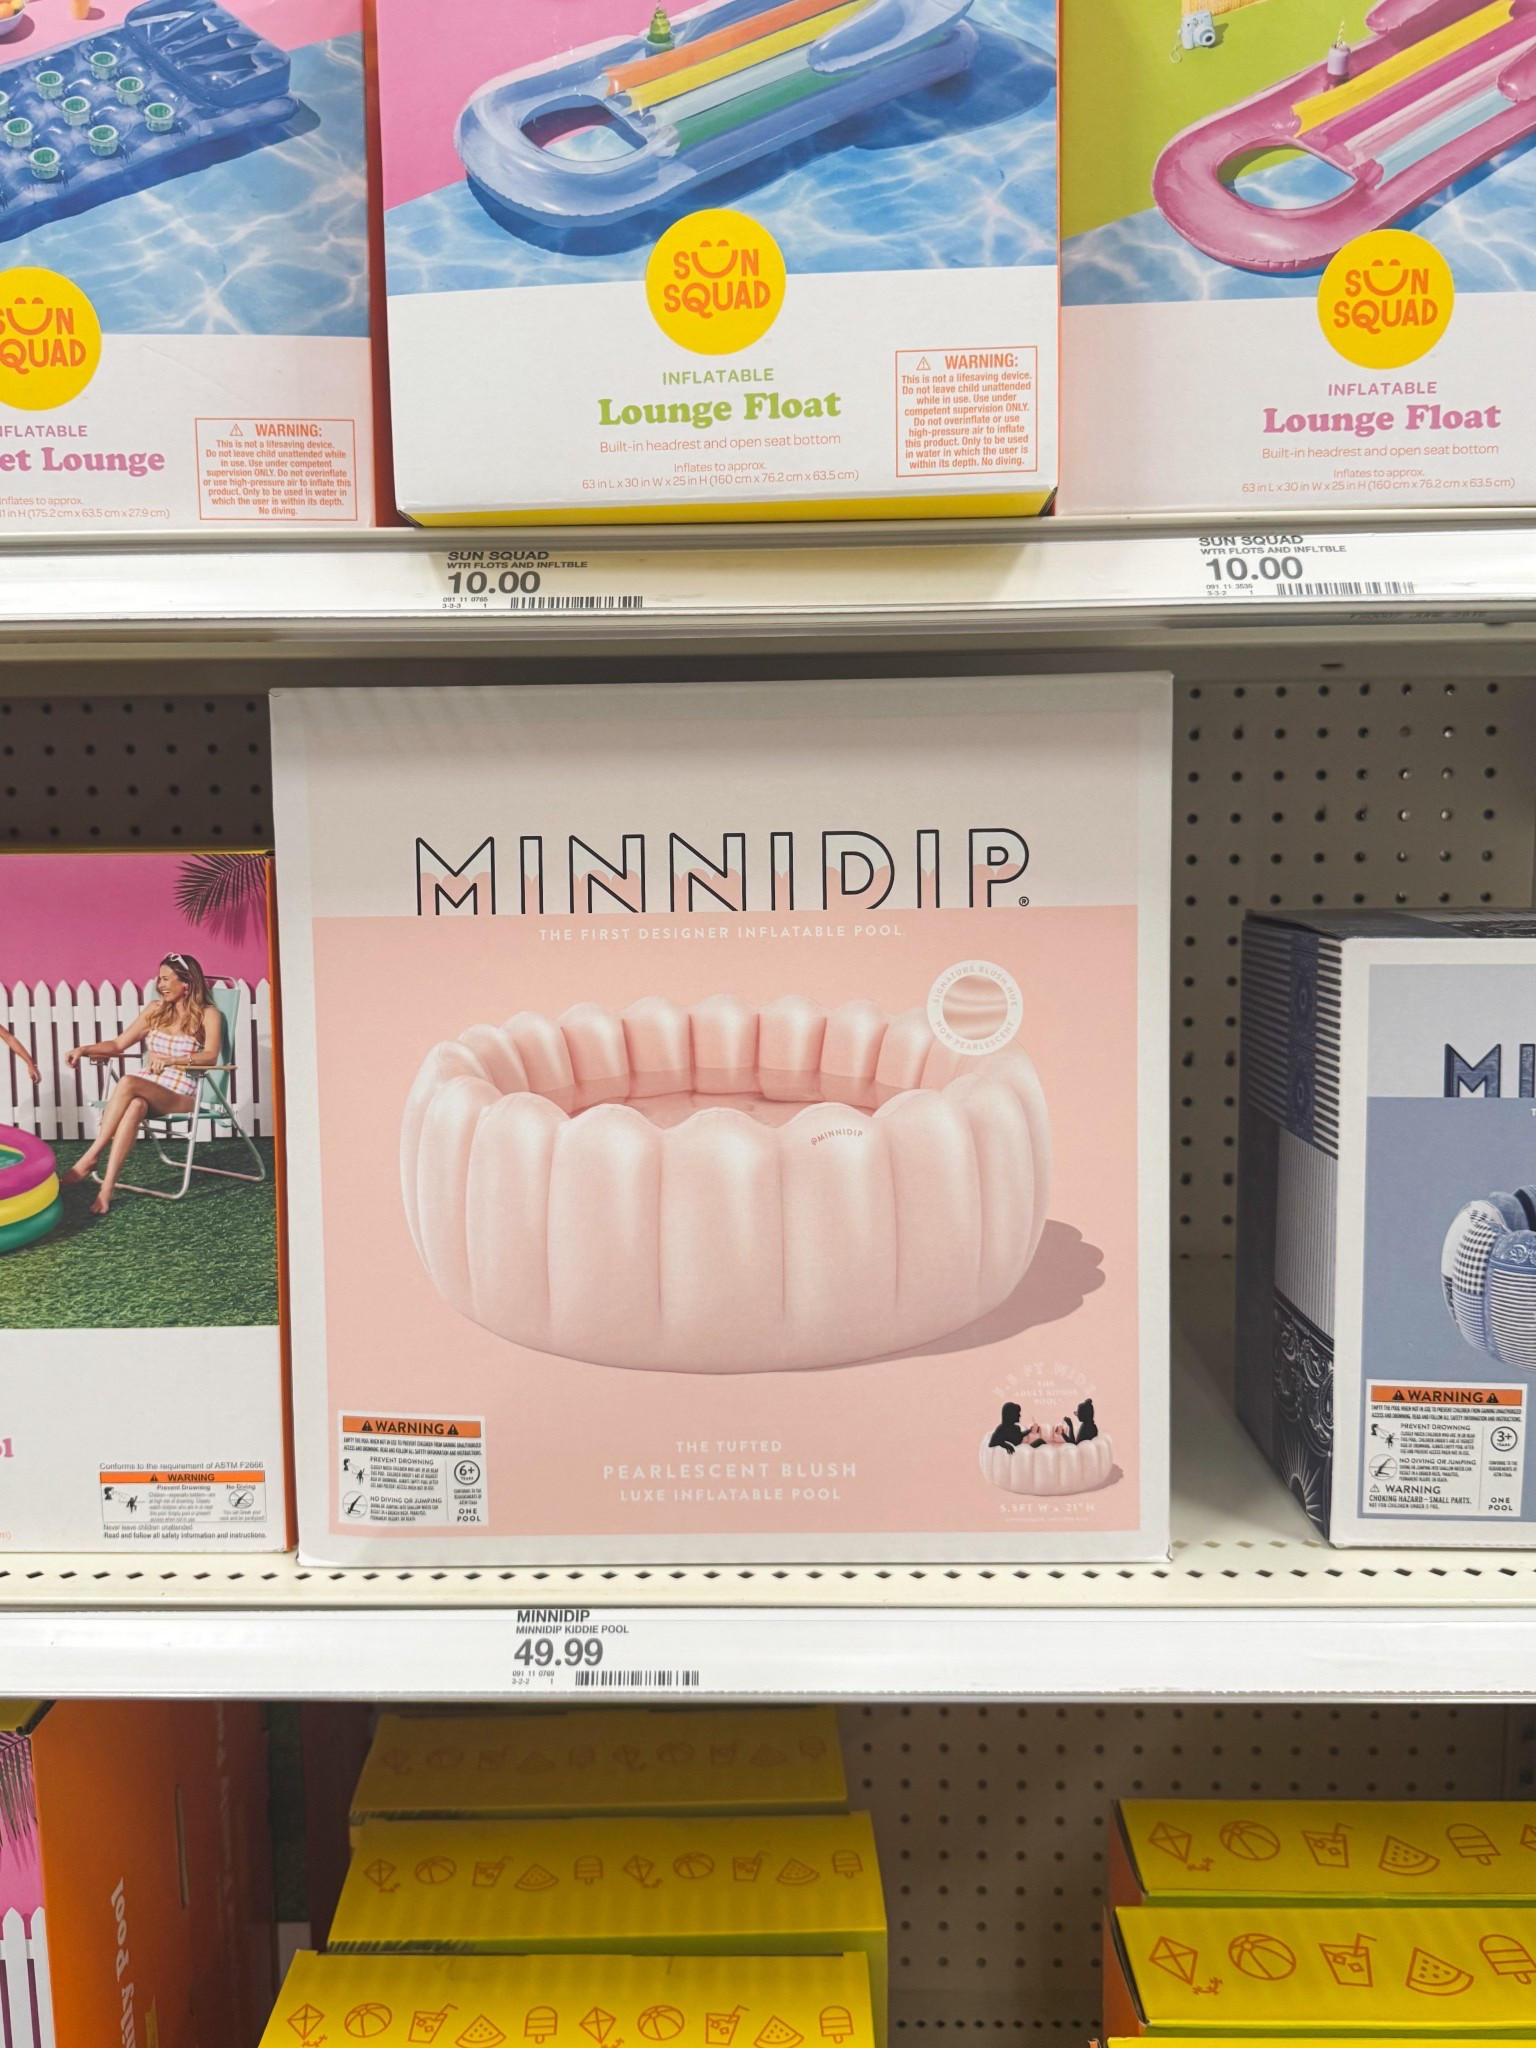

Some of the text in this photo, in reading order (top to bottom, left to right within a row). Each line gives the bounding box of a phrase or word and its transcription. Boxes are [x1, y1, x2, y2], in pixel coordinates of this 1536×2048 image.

[673, 240, 760, 277] SUN
[1344, 260, 1429, 297] SUN
[663, 286, 771, 319] SQUAD
[1333, 299, 1438, 334] SQUAD
[945, 353, 1018, 369] WARNING:
[662, 368, 774, 386] INFLATABLE
[902, 376, 919, 384] This
[922, 375, 929, 383] is
[932, 374, 946, 383] not
[957, 373, 998, 382] lifesaving
[1001, 372, 1032, 380] device.
[902, 382, 1031, 394] Do not leave child unattended
[1328, 382, 1437, 397] INFLATABLE
[598, 392, 841, 429] Lounge Float
[1263, 405, 1501, 437] Lounge Float
[255, 424, 322, 437] WARNING:
[217, 440, 233, 448] This
[236, 440, 243, 448] is
[267, 440, 304, 450] lifesaving
[307, 441, 335, 449] device.
[600, 434, 841, 453] Built-in headrest and open seat bottom
[1263, 443, 1499, 459] Built-in headrest and open seat bottom
[41, 447, 165, 477] Lounge
[674, 461, 766, 473] Inflates to approx.
[910, 457, 1024, 469] within its depth. No diving.
[272, 507, 298, 516] diving.
[1199, 536, 1304, 546] SUN SQUAD
[448, 552, 549, 560] SUN SQUAD
[1228, 547, 1265, 555] FLOTS
[1294, 545, 1347, 553] INFLTBLE
[1205, 556, 1303, 580] 10.00
[448, 571, 541, 594] 10.00
[416, 828, 1029, 915] MINNIDIP
[539, 929, 572, 941] THE
[581, 928, 630, 940] FIRST
[639, 927, 728, 939] DESIGNER
[738, 925, 846, 938] INFLATABLE
[933, 965, 1017, 1006] SIGNATURE BLUSH HUE
[935, 1021, 1013, 1050] NOW PEARLESCENT
[1408, 1390, 1483, 1403] WARNING
[376, 1420, 444, 1435] WARNING
[1497, 1431, 1512, 1442] 3+
[677, 1441, 782, 1452] THE TUFTED
[370, 1456, 397, 1464] PREVENT
[168, 1473, 215, 1482] WARNING
[459, 1465, 475, 1475] 6+
[604, 1463, 856, 1480] PEARLESCENT BLUSH
[620, 1488, 841, 1502] LUXE INFLATABLE POOL
[1385, 1484, 1441, 1494] WARNING
[517, 1609, 590, 1623] MINNIDIP
[515, 1625, 629, 1634] MINNIDIP KIDDIE POOL
[514, 1637, 603, 1666] 49.99
